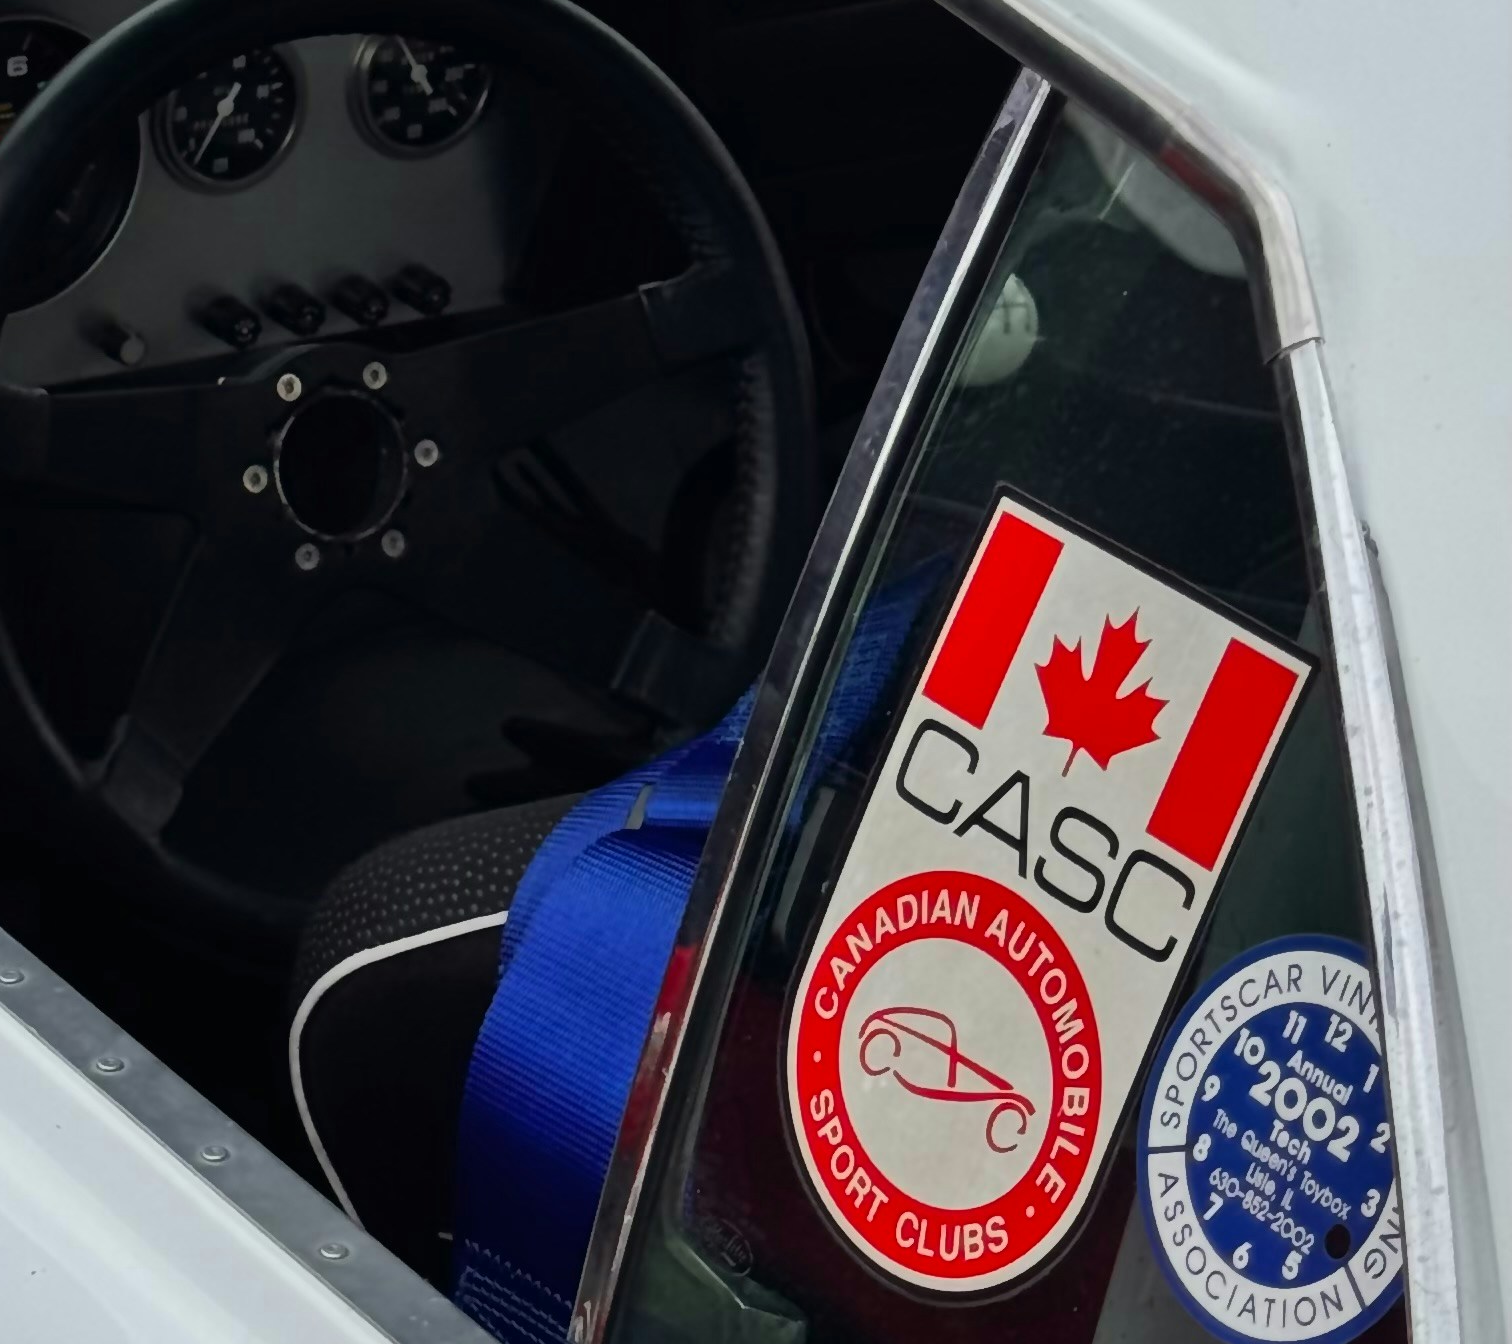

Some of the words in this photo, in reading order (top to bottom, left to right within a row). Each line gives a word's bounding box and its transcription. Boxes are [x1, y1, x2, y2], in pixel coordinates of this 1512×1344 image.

[6, 54, 30, 78] 6
[895, 717, 1196, 964] CASC
[814, 889, 981, 1020] CANADIAN
[985, 908, 1091, 1204] AUTOMOBILE
[1160, 964, 1303, 1130] SPORTSCAR
[1233, 1027, 1265, 1065] 10
[1282, 1010, 1307, 1045] 11
[1324, 1013, 1353, 1053] 12
[1200, 1074, 1221, 1102] 9
[1286, 1049, 1354, 1106] Annual
[1362, 1064, 1379, 1093] 1
[1248, 1060, 1360, 1163] 2002
[1192, 1133, 1212, 1162] 8
[1269, 1118, 1312, 1164] Tech
[1370, 1122, 1390, 1153] 2
[810, 1088, 889, 1223] SPORT
[896, 1211, 1009, 1261] CLUBS
[1212, 1108, 1238, 1139] The
[1241, 1129, 1297, 1182] Queen's
[1300, 1170, 1352, 1221] Toybox
[1203, 1192, 1224, 1221] 7
[1209, 1167, 1315, 1255] 630-852-2002
[1361, 1188, 1381, 1218] 3
[1157, 1172, 1344, 1328] ASSOCIATION
[1232, 1241, 1252, 1269] 6
[1281, 1250, 1302, 1280] 5
